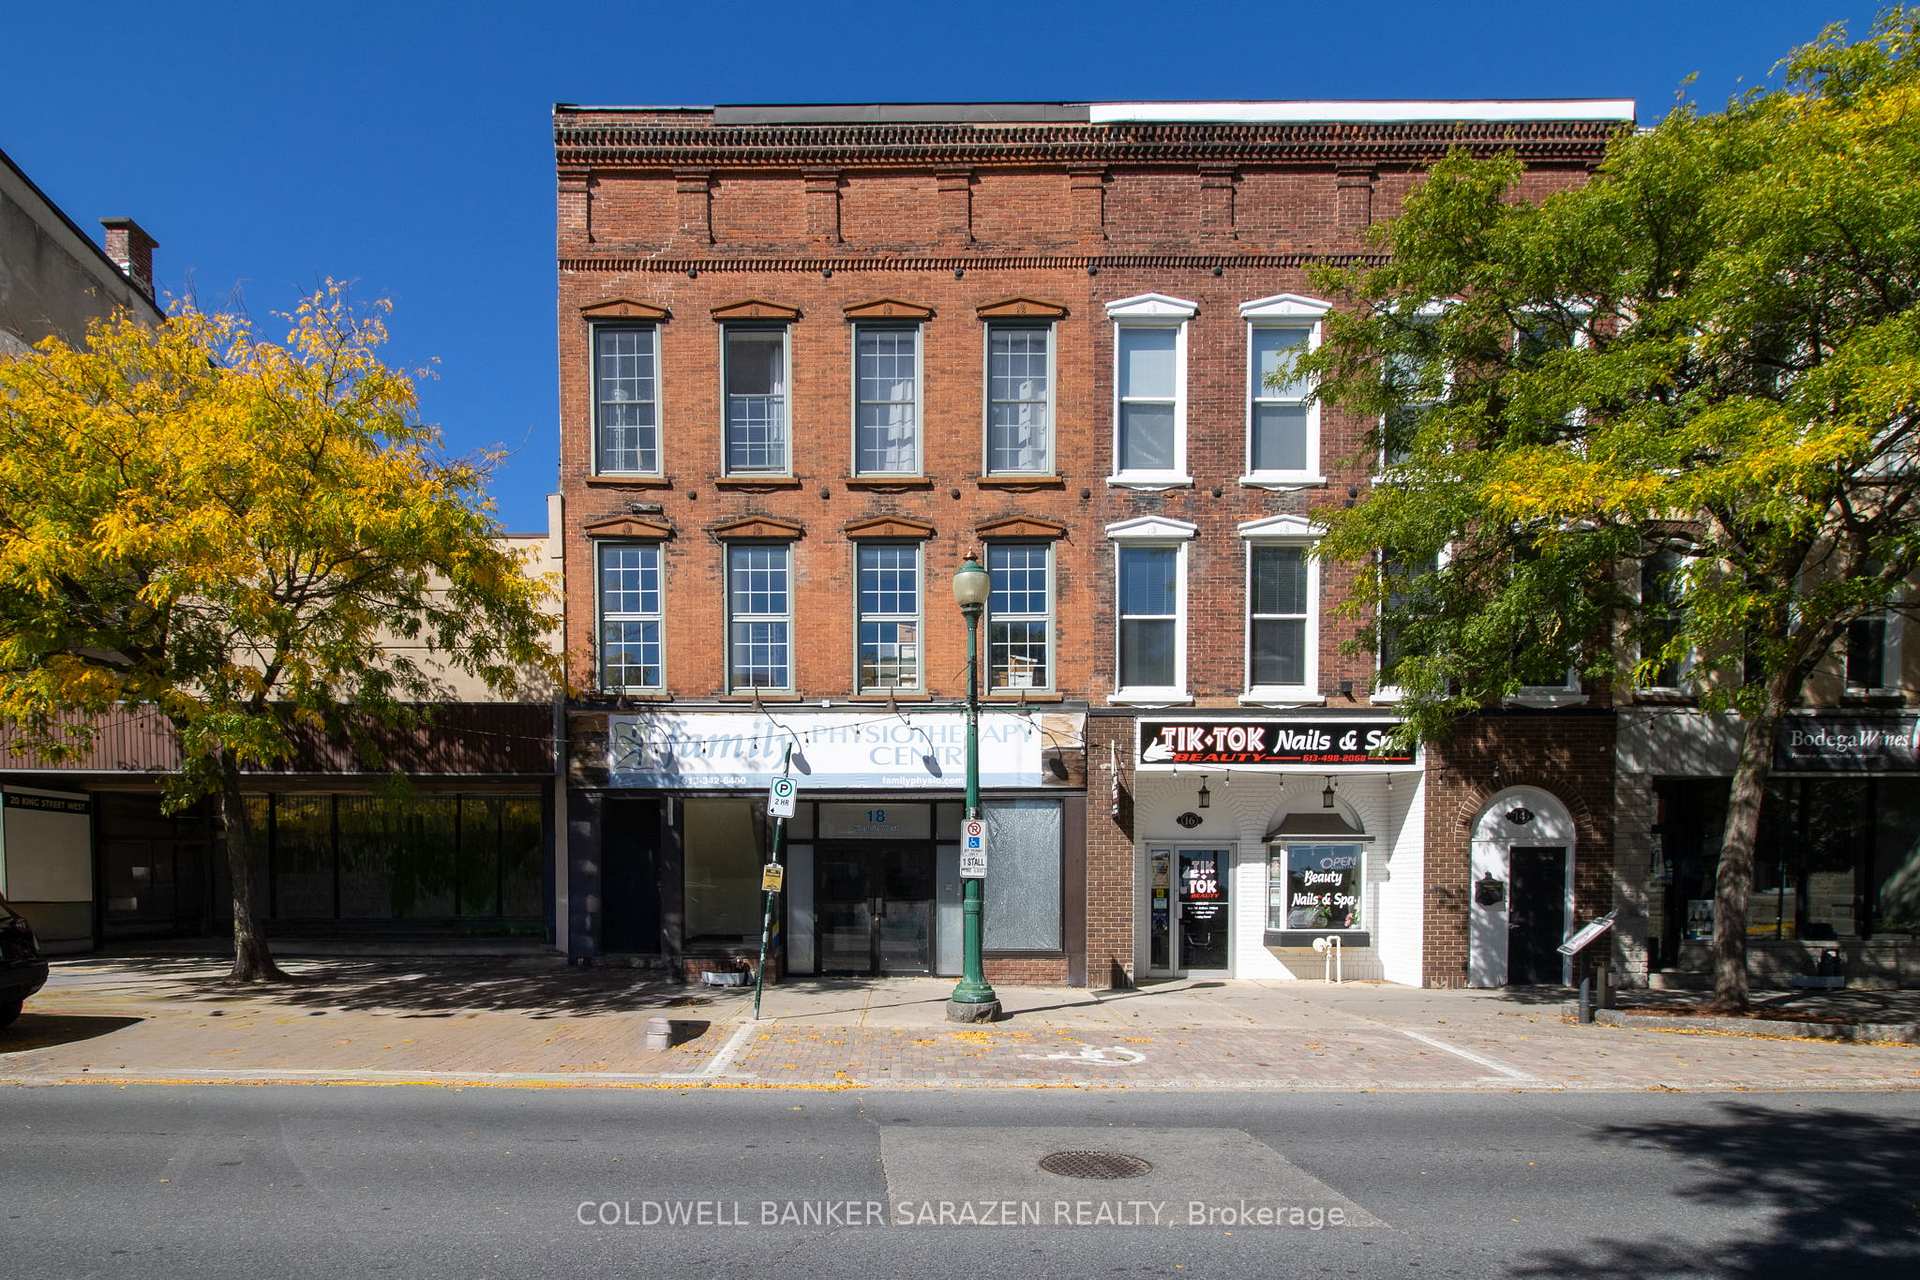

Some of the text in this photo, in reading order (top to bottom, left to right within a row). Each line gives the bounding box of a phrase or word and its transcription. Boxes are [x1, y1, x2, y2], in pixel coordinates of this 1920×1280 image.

[812, 723, 1031, 745] PHYSIOTHEAPY
[1272, 729, 1332, 754] Nails
[1339, 730, 1358, 751] &
[869, 745, 967, 766] CENTR
[1173, 753, 1267, 762] BEAUTY
[866, 809, 886, 823] 18
[1184, 815, 1197, 826] 16
[967, 857, 985, 866] STALL
[1191, 860, 1216, 875] TIK
[1304, 870, 1343, 886] Beauty
[1189, 879, 1217, 894] TOK
[1291, 892, 1355, 909] Nails & Spa
